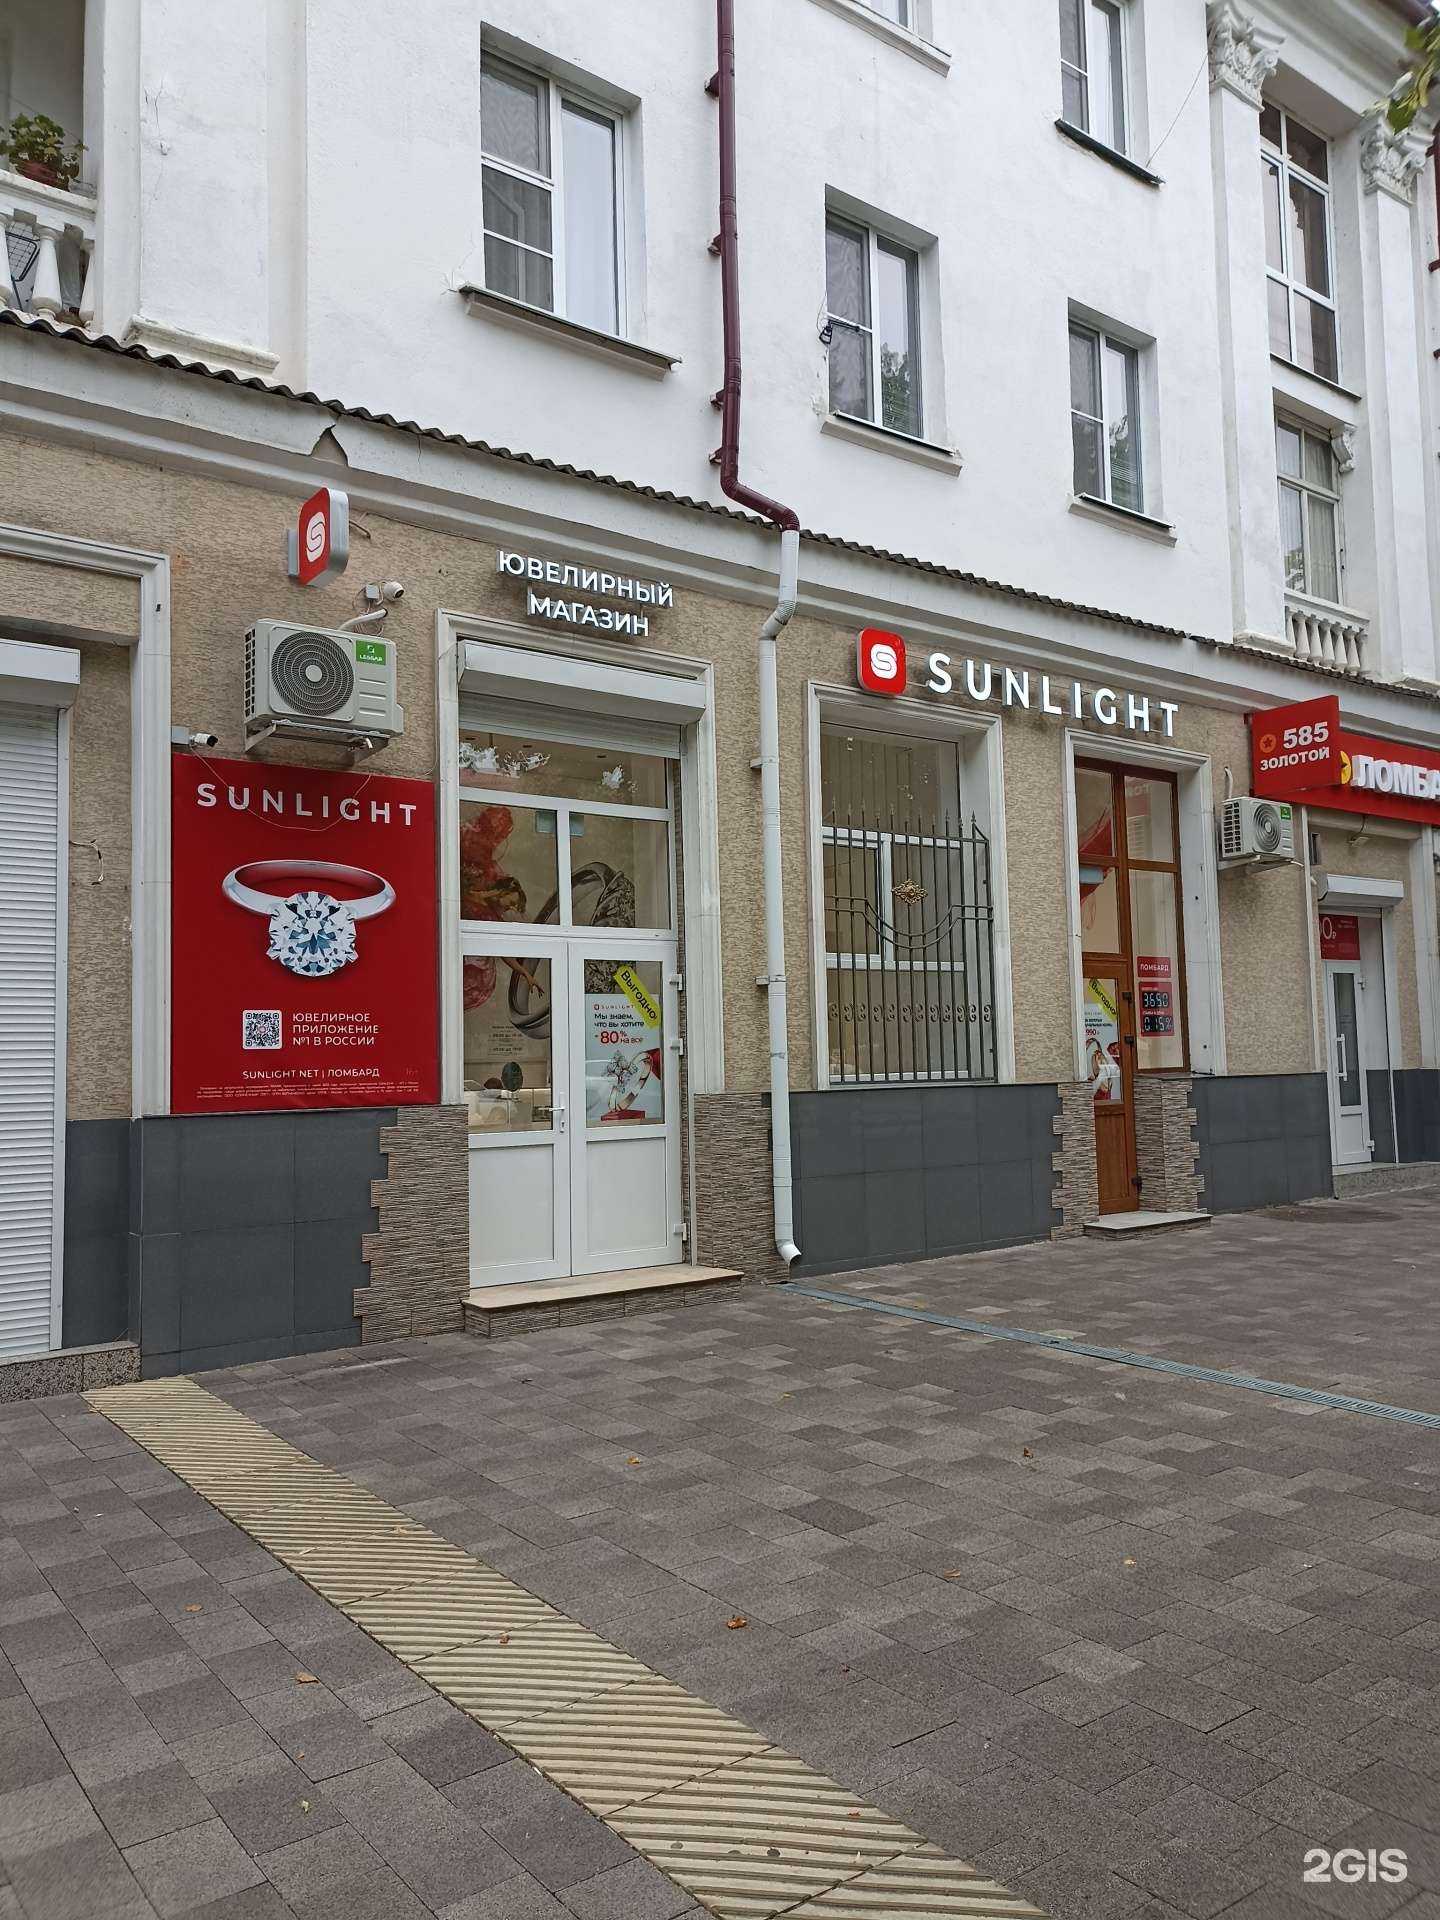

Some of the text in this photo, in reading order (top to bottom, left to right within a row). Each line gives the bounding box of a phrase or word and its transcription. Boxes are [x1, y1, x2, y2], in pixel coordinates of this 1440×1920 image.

[497, 549, 674, 608] ЮВЕЛИРНЫЙ
[528, 592, 650, 638] МАГАЗИН
[926, 652, 1179, 737] SUNLIGHT
[1283, 721, 1329, 749] 585
[197, 783, 417, 826] SUNLIGHT
[292, 1012, 371, 1022] ЮВЕЛИРНОЕ
[292, 1024, 379, 1034] ПРИЛОЖЕНИЕ
[313, 1036, 322, 1046] В
[325, 1036, 375, 1046] РОССИИ
[242, 1070, 296, 1079] SUNLIGHT
[327, 1068, 380, 1077] ЛОМБАРД
